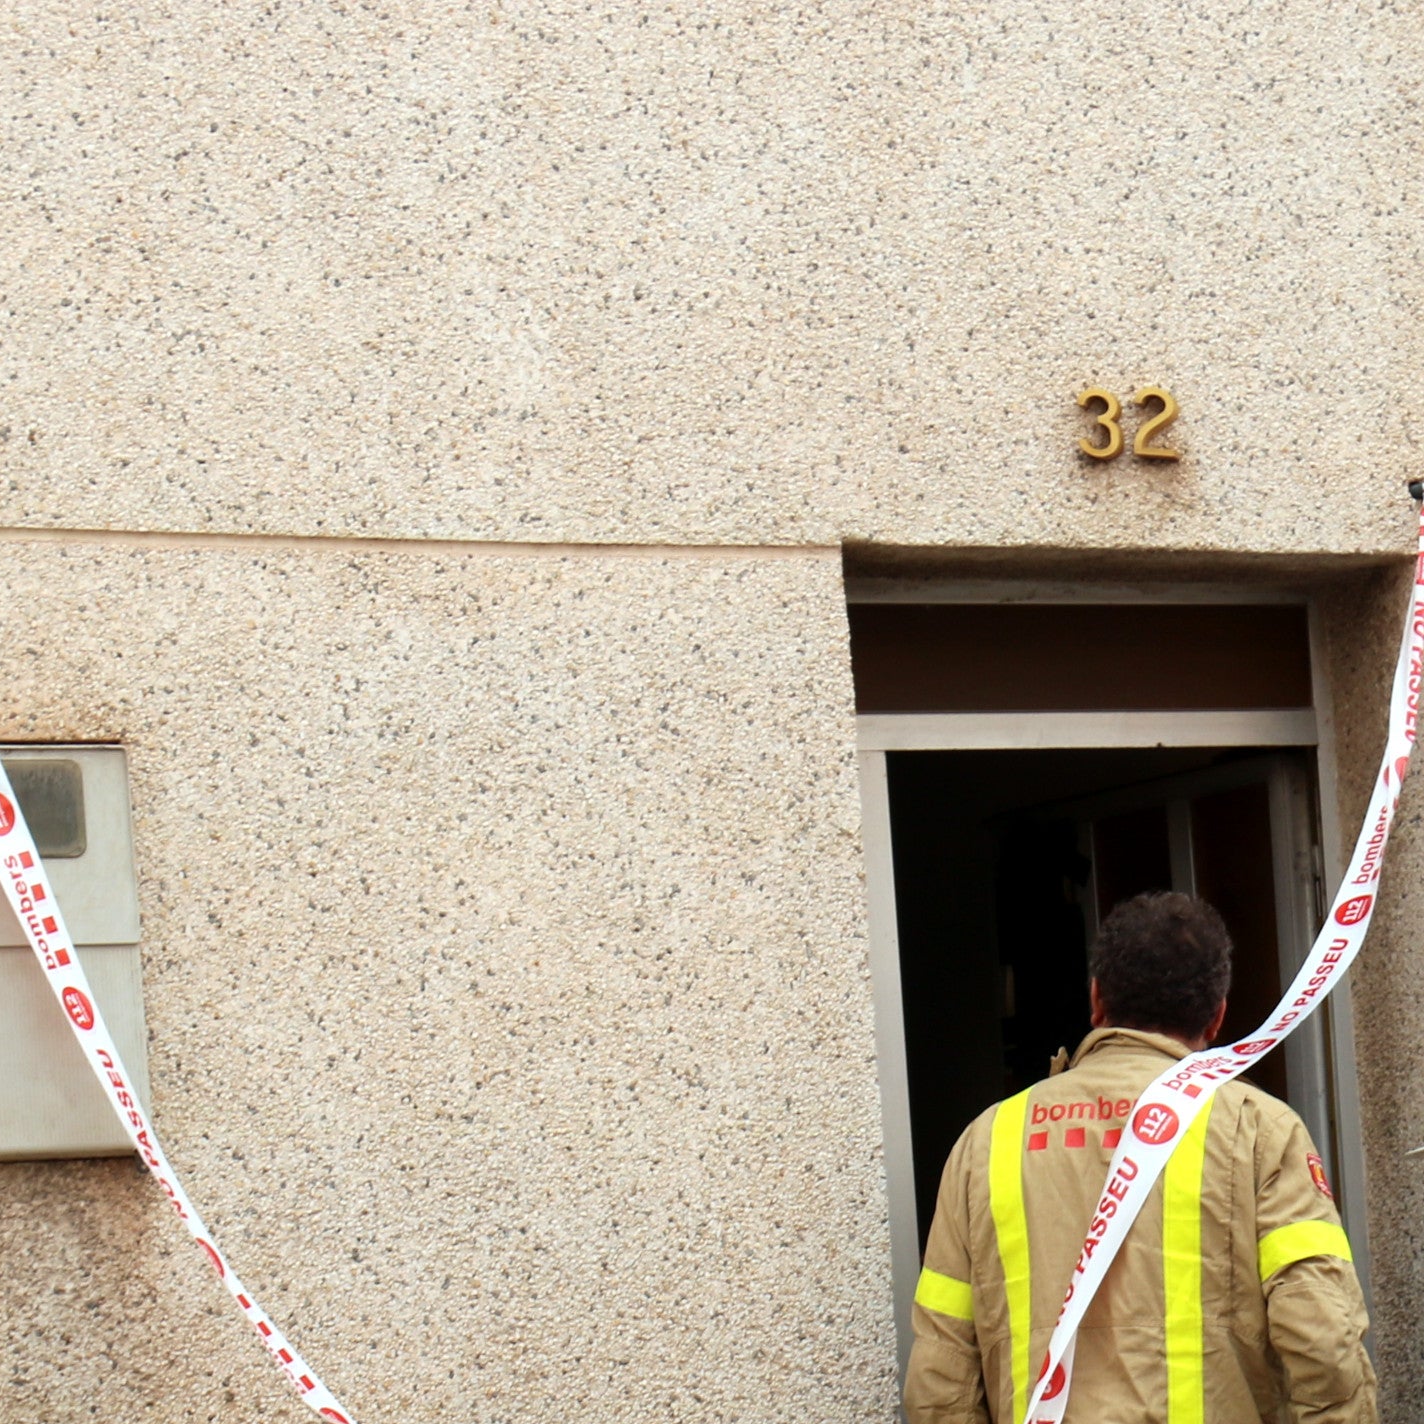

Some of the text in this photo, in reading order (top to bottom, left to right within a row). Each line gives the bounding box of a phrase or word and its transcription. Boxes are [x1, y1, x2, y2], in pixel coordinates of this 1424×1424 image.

[1076, 386, 1182, 461] 32
[4, 854, 57, 970] bombers
[1343, 900, 1364, 921] 112
[1269, 938, 1349, 1033] NO PASSEU
[1162, 1055, 1232, 1090] bombers
[1031, 1095, 1139, 1125] bombe
[1139, 1107, 1168, 1138] 112
[1075, 1155, 1139, 1274] PASSEU
